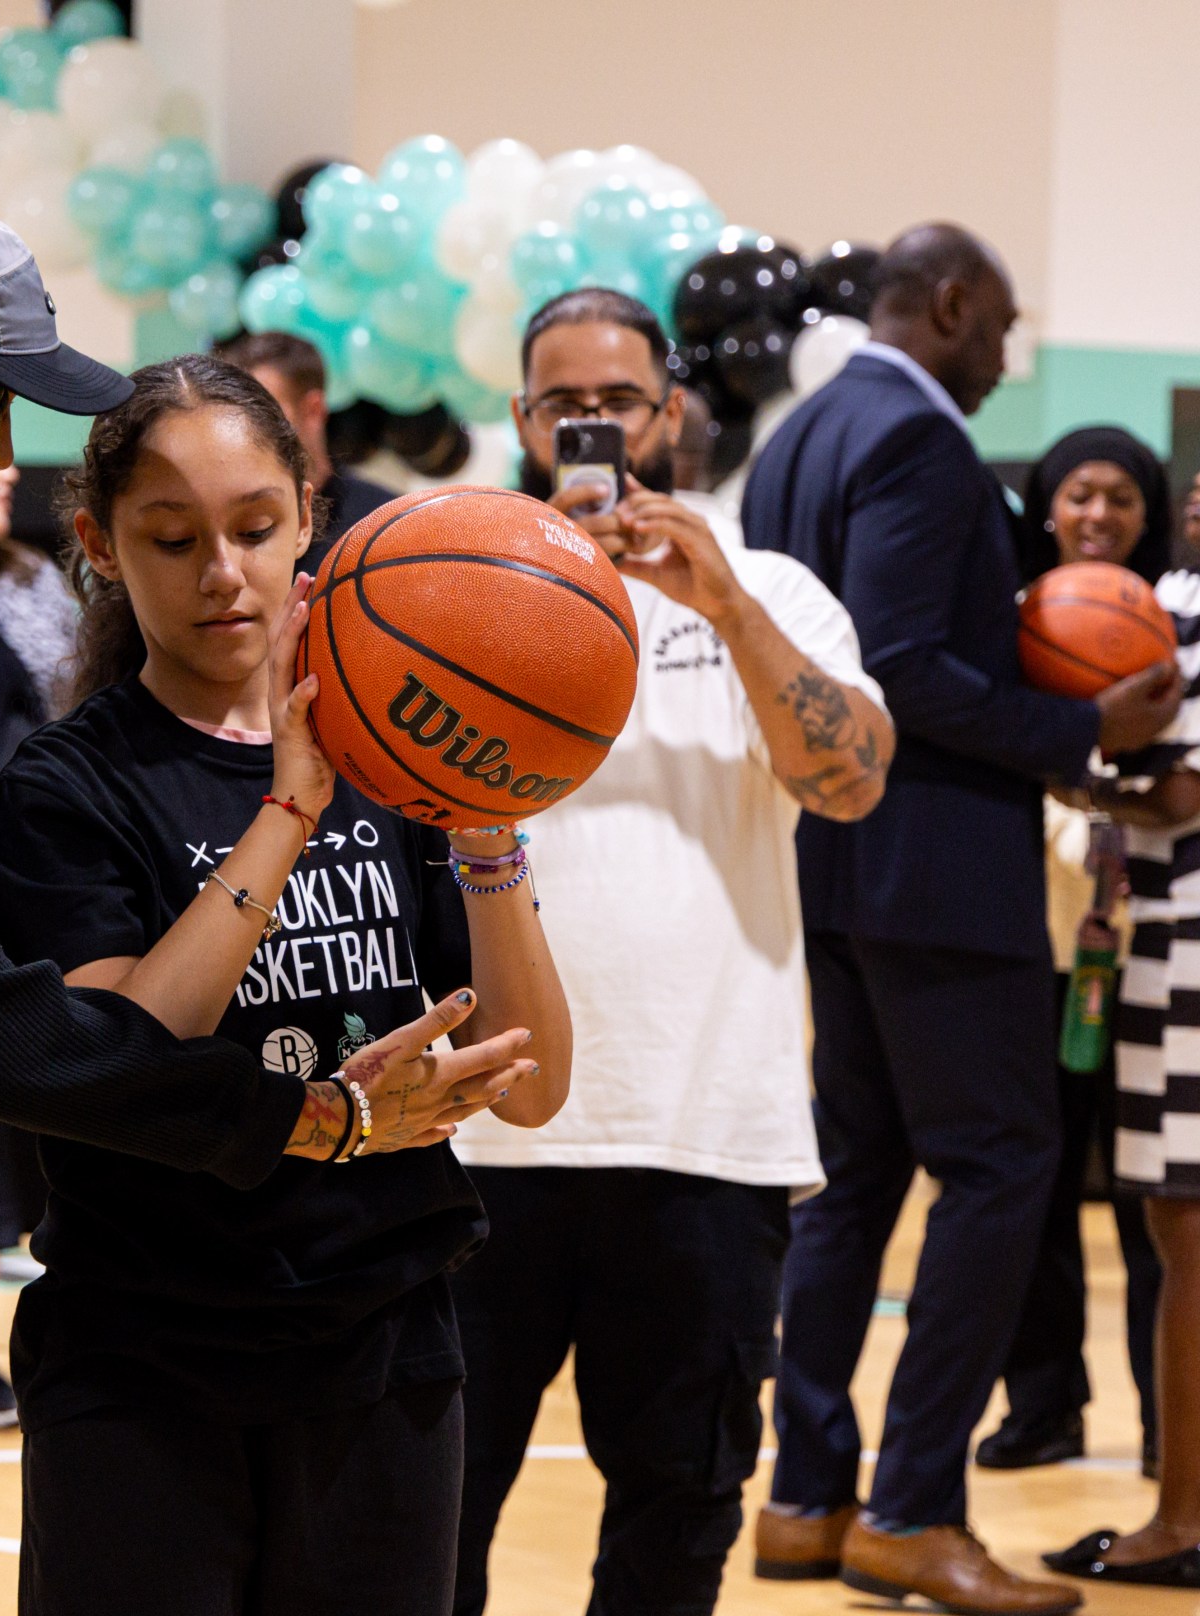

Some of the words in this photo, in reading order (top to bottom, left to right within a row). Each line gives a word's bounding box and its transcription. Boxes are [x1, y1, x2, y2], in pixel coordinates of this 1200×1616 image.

[388, 671, 574, 801] Wilson
[198, 860, 400, 931] OKLYN
[234, 926, 420, 1008] SKETBAL
[279, 1034, 300, 1076] B
